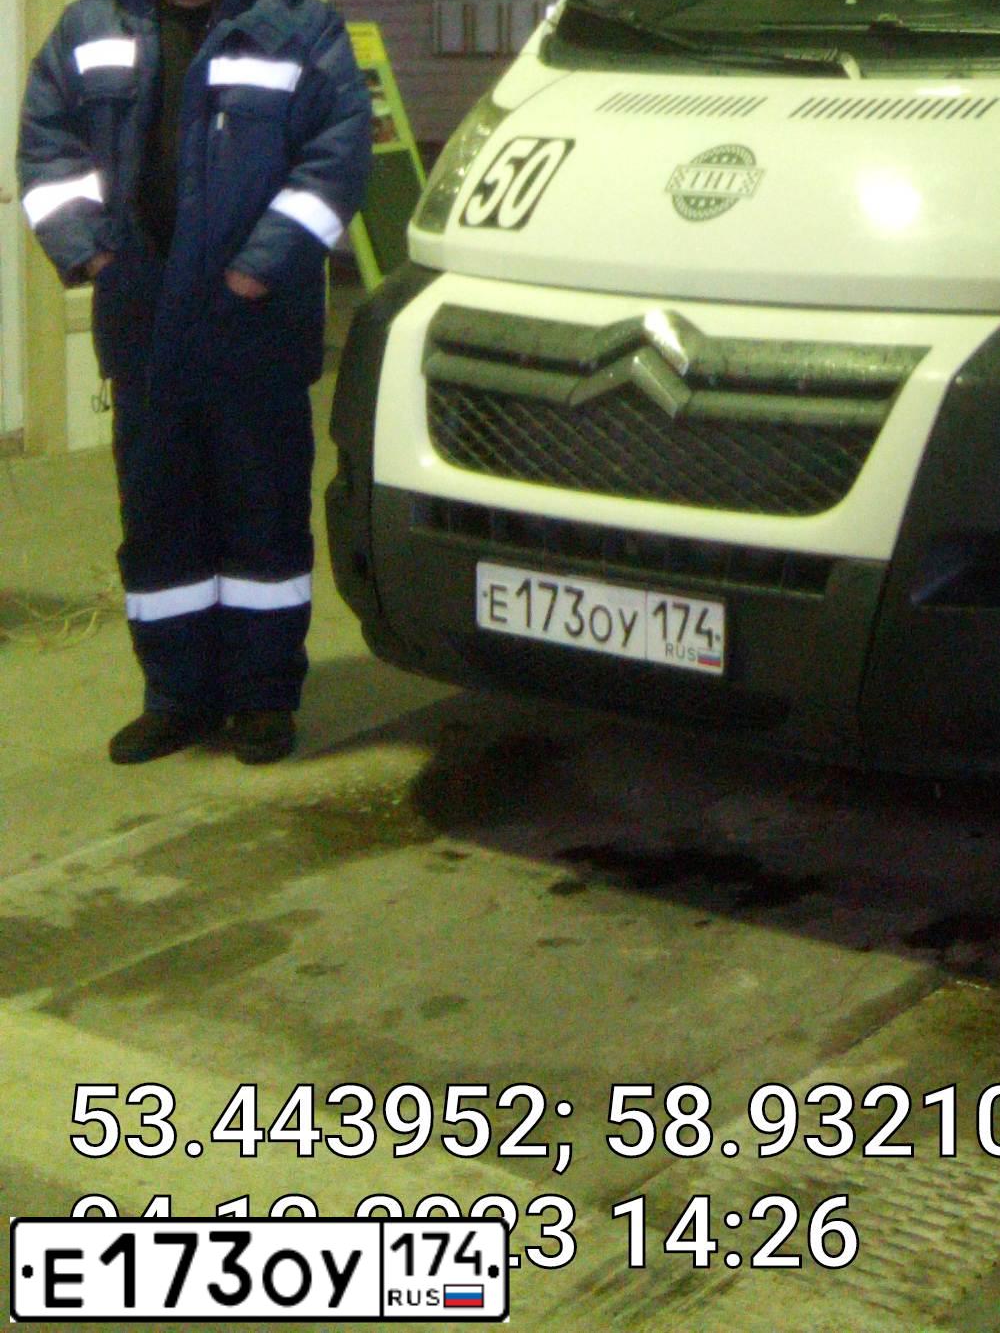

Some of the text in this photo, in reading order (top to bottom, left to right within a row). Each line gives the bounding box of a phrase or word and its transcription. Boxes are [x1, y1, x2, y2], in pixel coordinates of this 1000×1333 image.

[465, 138, 567, 228] 50
[653, 600, 713, 648] 174
[665, 642, 697, 662] RUS
